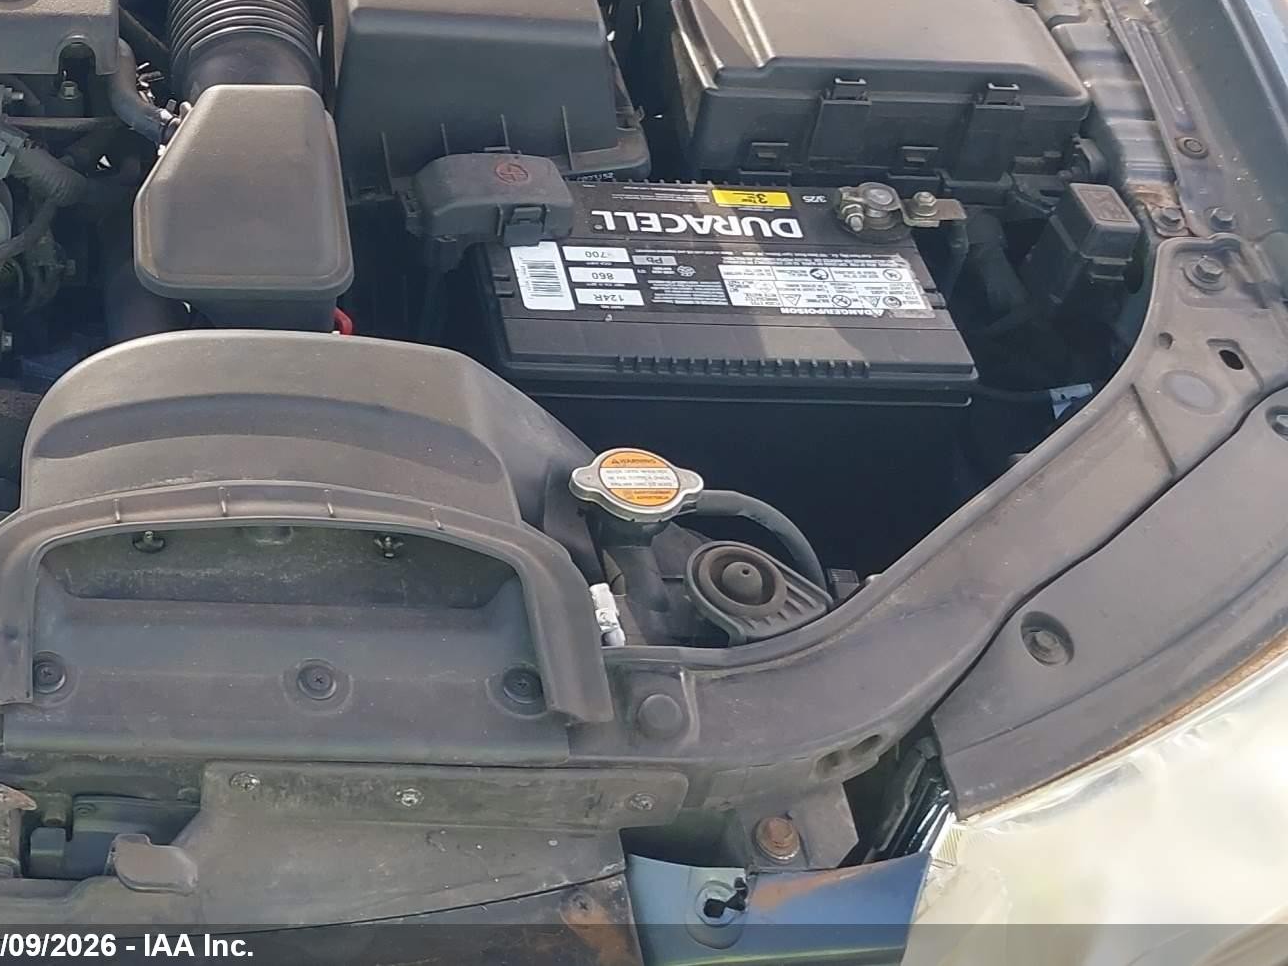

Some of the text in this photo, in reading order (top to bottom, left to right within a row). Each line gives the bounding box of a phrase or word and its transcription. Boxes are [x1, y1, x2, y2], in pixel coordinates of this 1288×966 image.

[756, 193, 769, 205] 3
[591, 210, 803, 238] DURACELL
[585, 250, 607, 259] 700
[646, 256, 664, 264] Pb
[591, 271, 614, 281] 860
[593, 293, 624, 302] 124R
